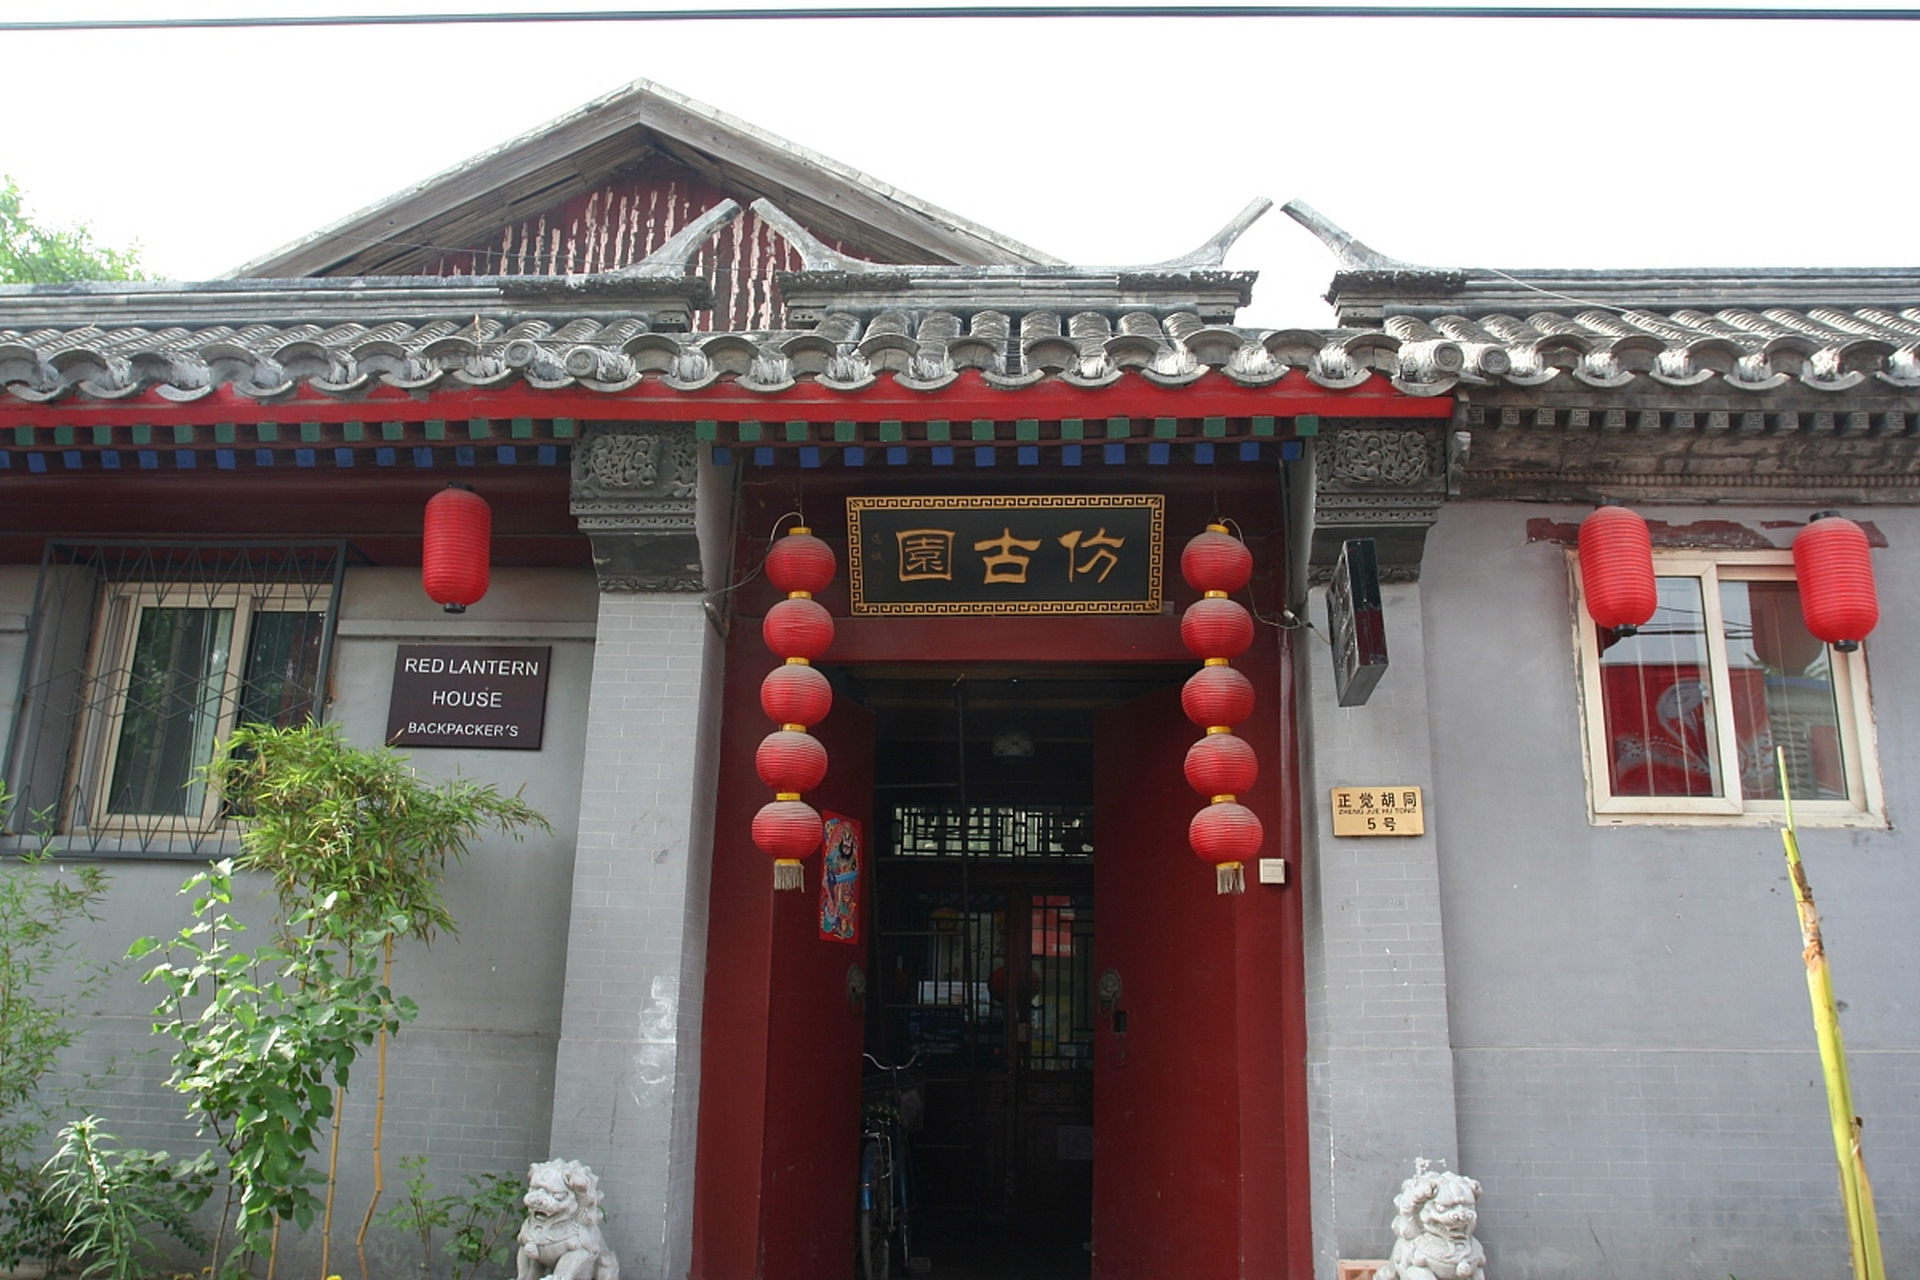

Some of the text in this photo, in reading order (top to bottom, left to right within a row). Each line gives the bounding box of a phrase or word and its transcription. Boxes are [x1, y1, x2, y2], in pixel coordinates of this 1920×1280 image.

[404, 658, 539, 676] RED LANTERN
[432, 690, 503, 708] HOUSE
[408, 722, 519, 737] BACKPACKER'S
[1338, 792, 1417, 808] 正觉胡同
